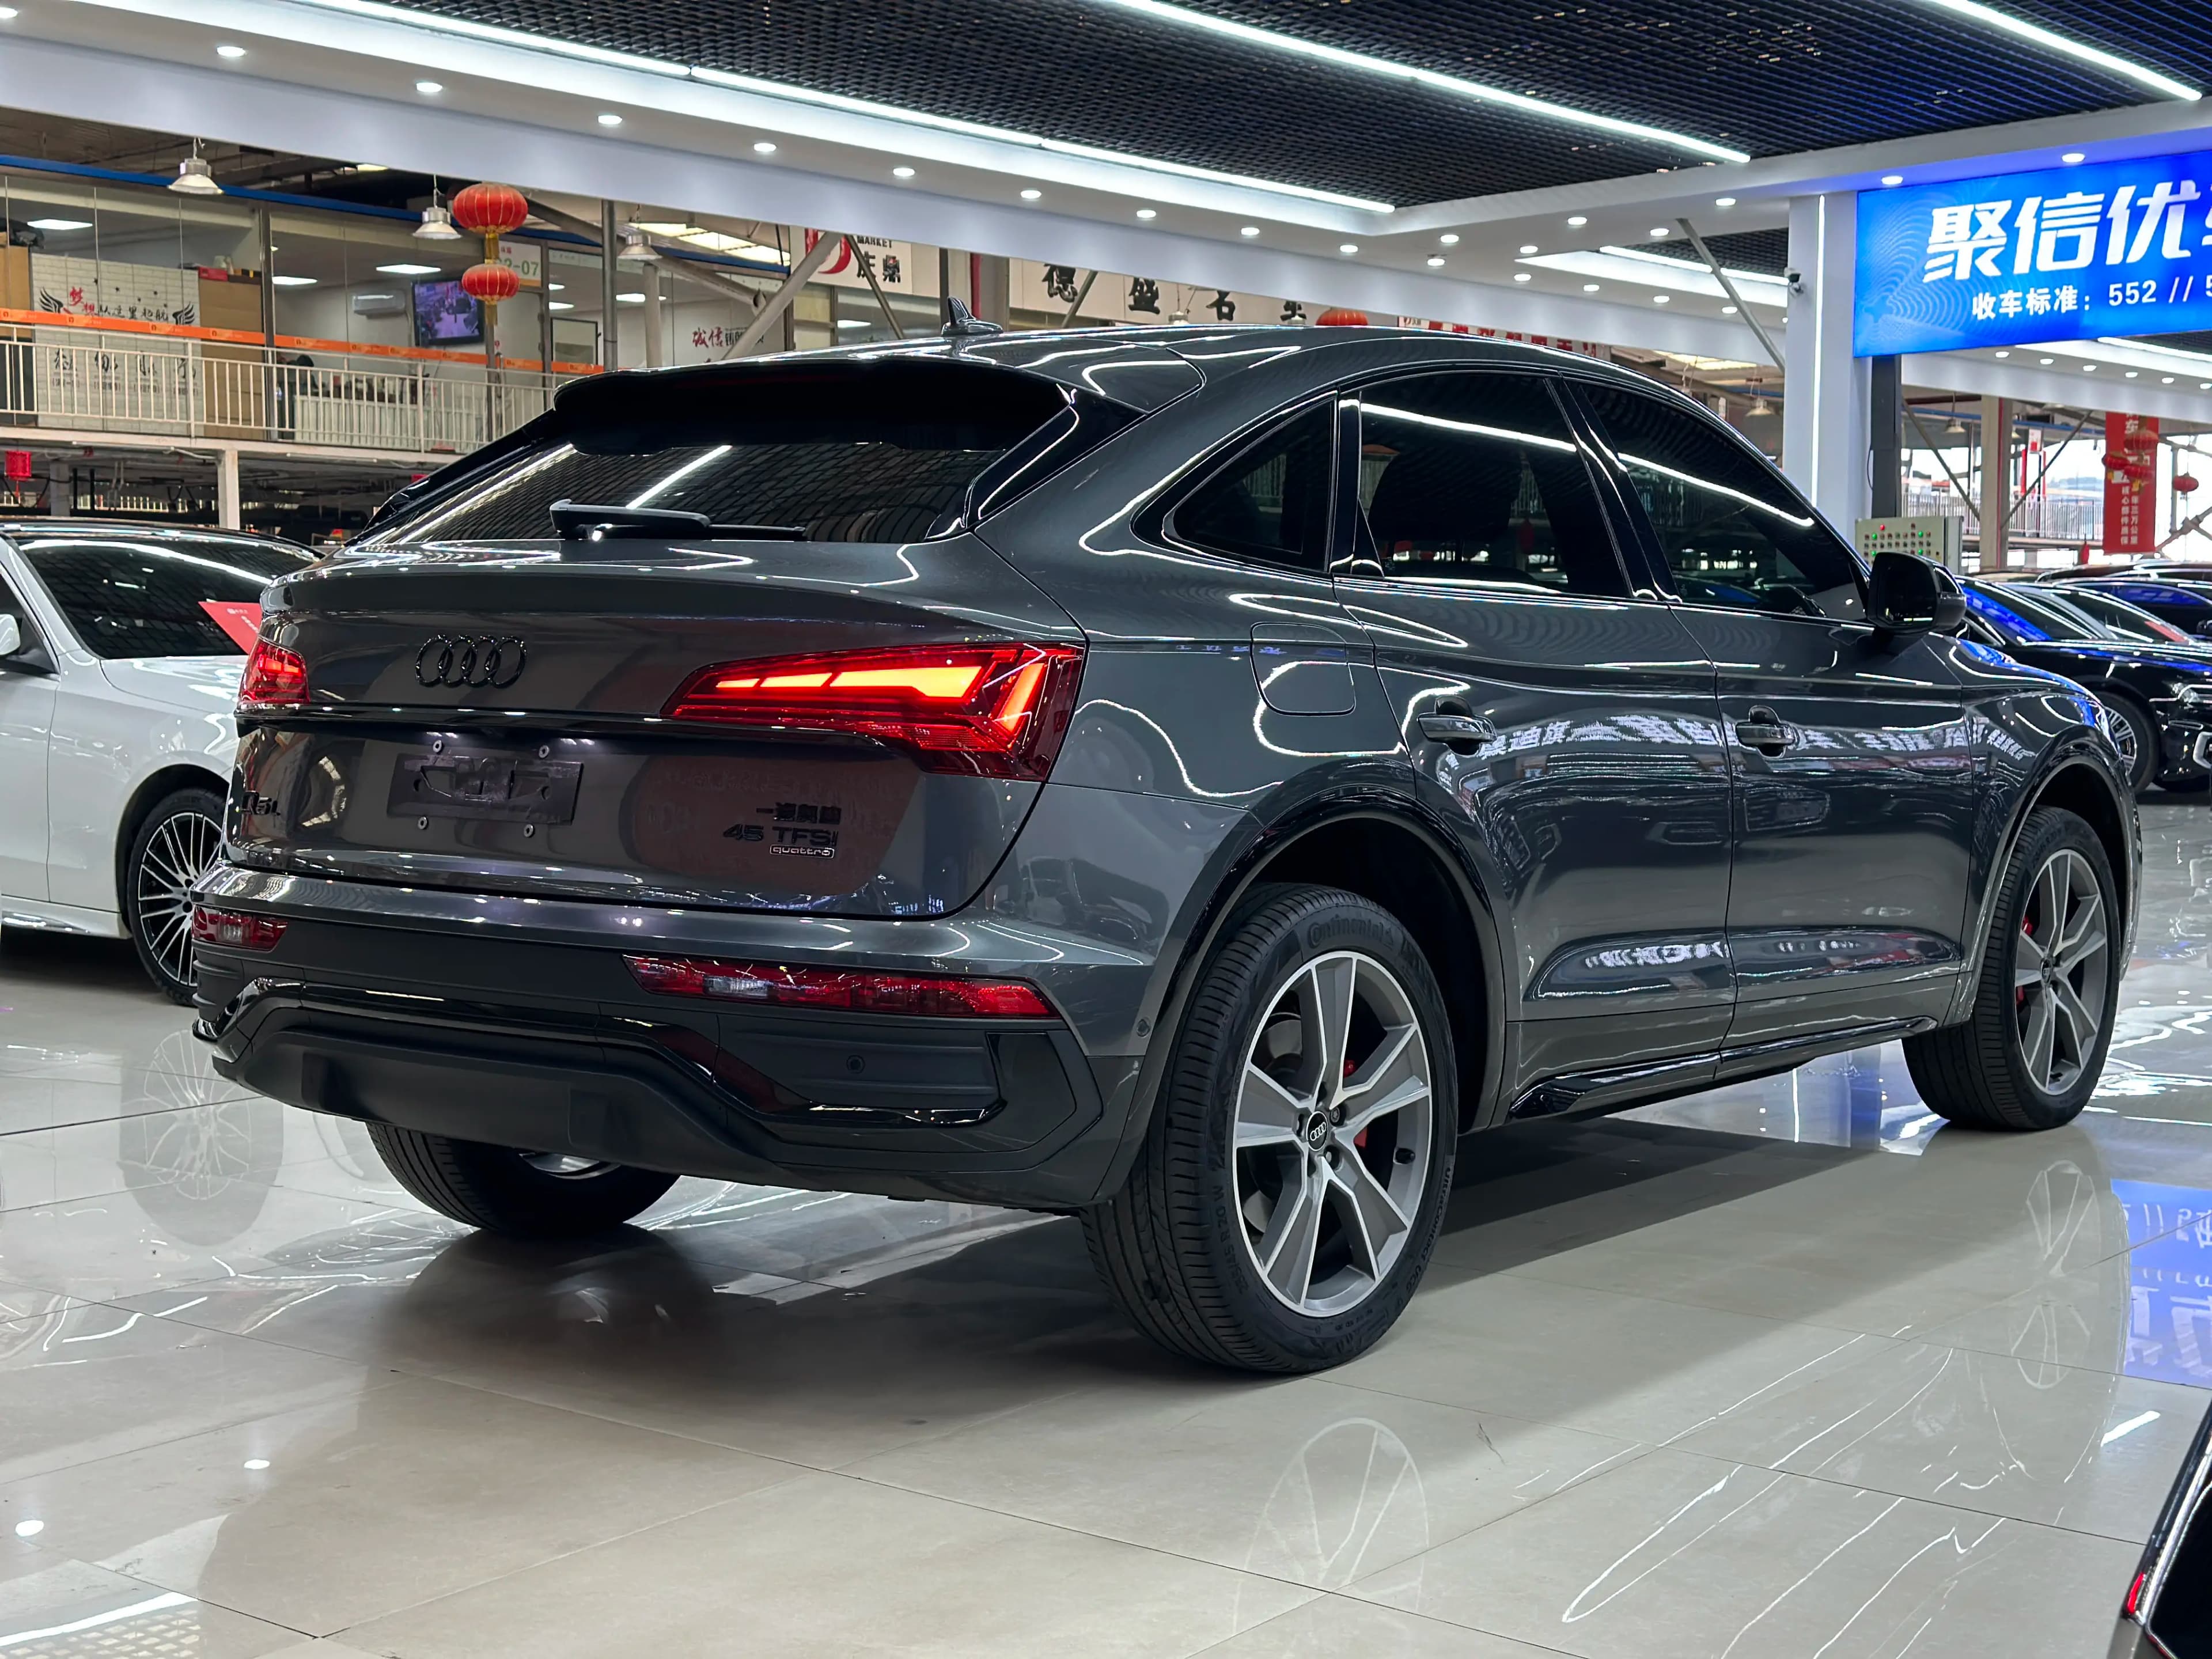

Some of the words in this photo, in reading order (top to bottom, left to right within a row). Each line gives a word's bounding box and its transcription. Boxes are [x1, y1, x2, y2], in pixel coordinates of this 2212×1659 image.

[857, 235, 893, 248] MARKET
[1923, 180, 2212, 283] 聚信优
[2108, 280, 2157, 306] 552
[242, 791, 281, 816] Q5L
[723, 823, 764, 842] 45
[771, 825, 839, 847] TFSI
[772, 846, 831, 857] quattro
[1307, 914, 1385, 949] Continental
